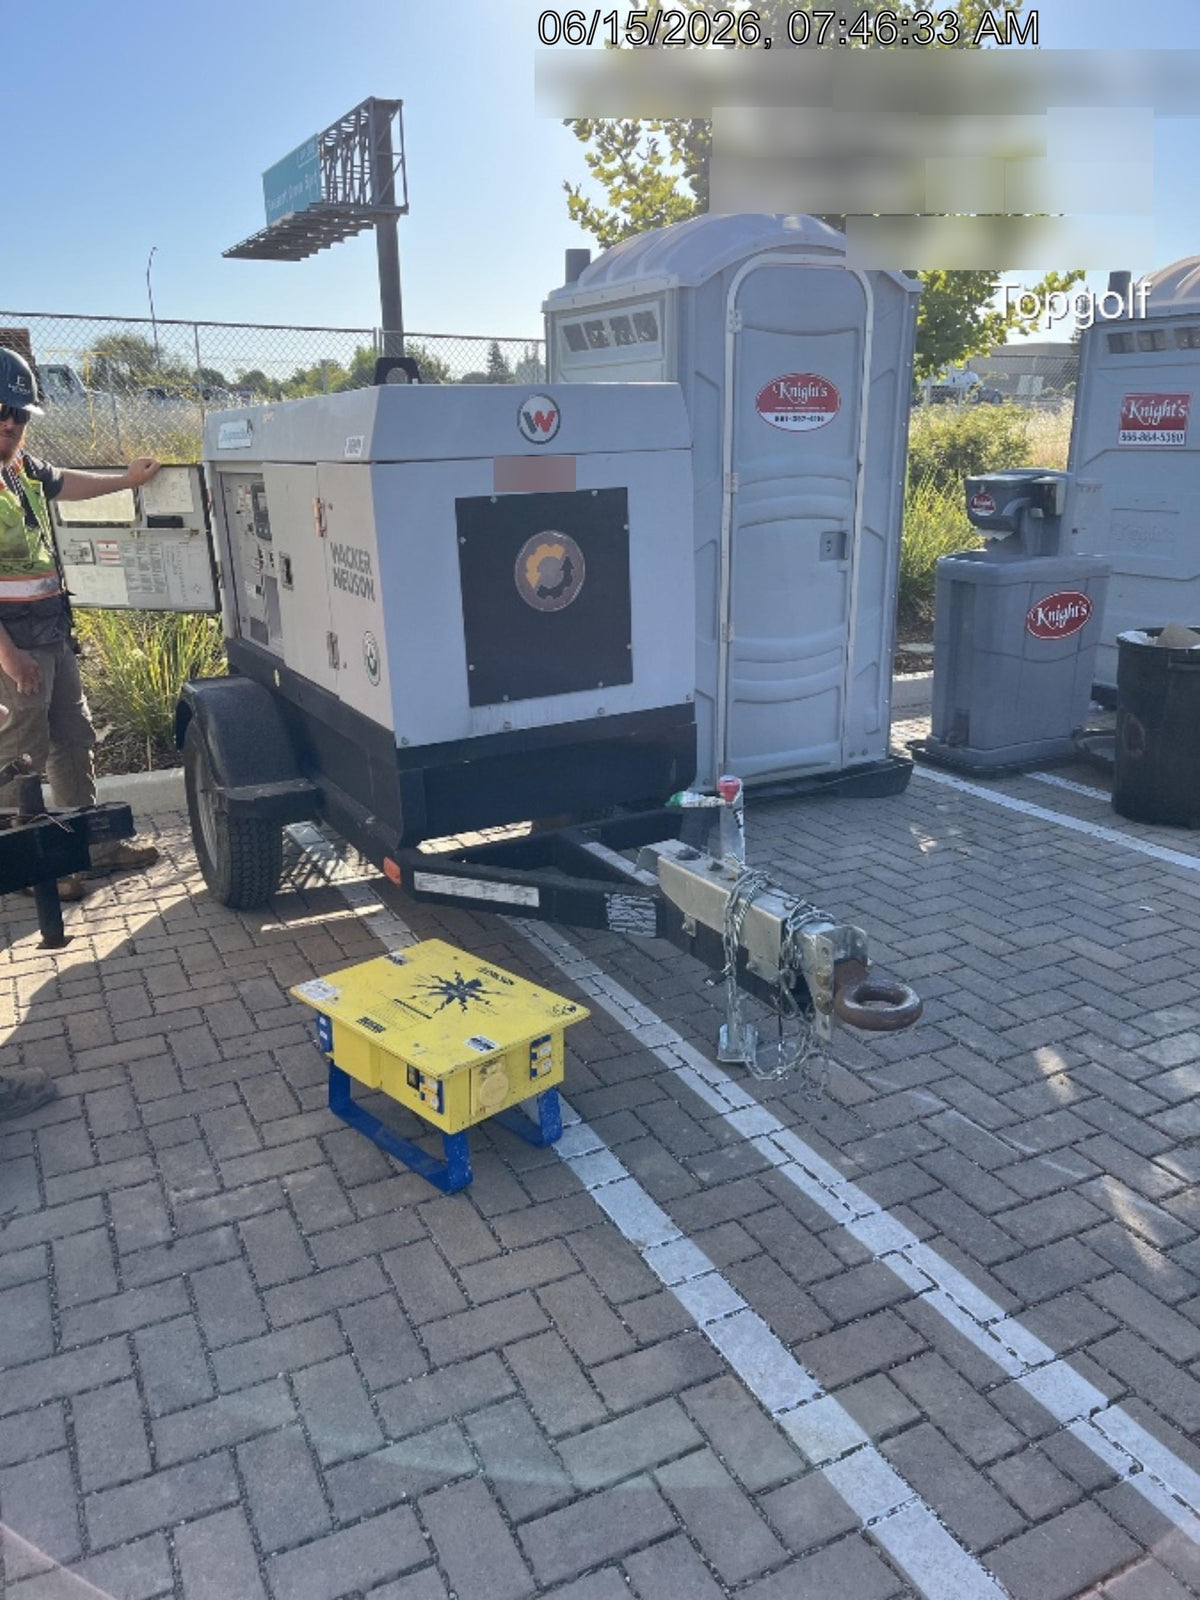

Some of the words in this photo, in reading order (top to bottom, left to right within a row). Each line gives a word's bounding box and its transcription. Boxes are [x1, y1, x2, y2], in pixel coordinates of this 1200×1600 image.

[773, 381, 828, 405] Knight's
[1124, 399, 1188, 426] Knight's
[329, 541, 372, 576] WACKER
[332, 566, 376, 602] NEUSON
[1031, 600, 1088, 630] Knight's
